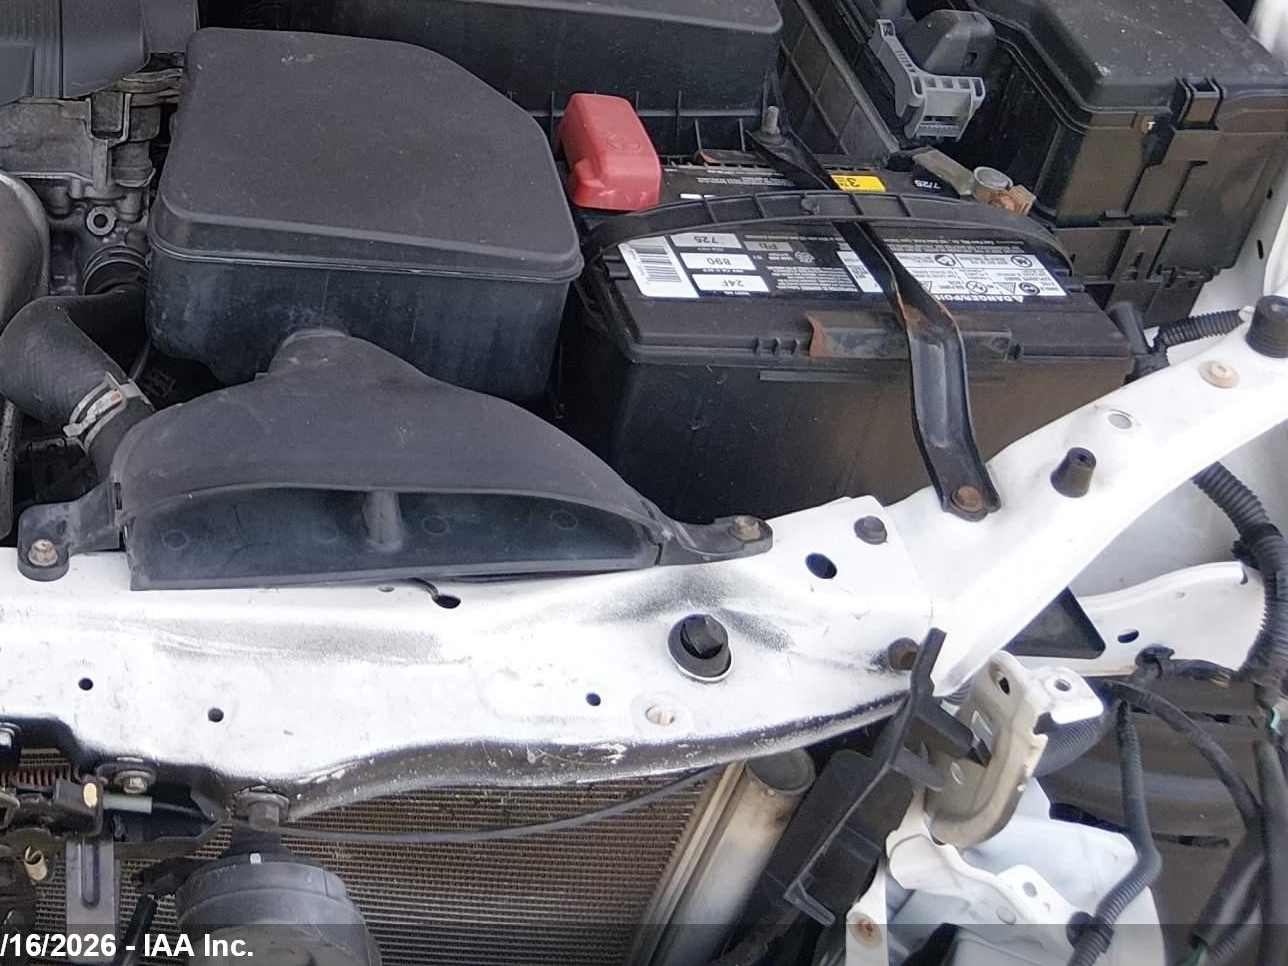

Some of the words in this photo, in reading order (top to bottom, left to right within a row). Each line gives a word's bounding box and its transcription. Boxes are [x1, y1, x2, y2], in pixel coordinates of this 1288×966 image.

[913, 178, 942, 190] 7/25
[693, 235, 720, 245] 725
[705, 257, 732, 267] 890
[720, 279, 745, 289] 24F
